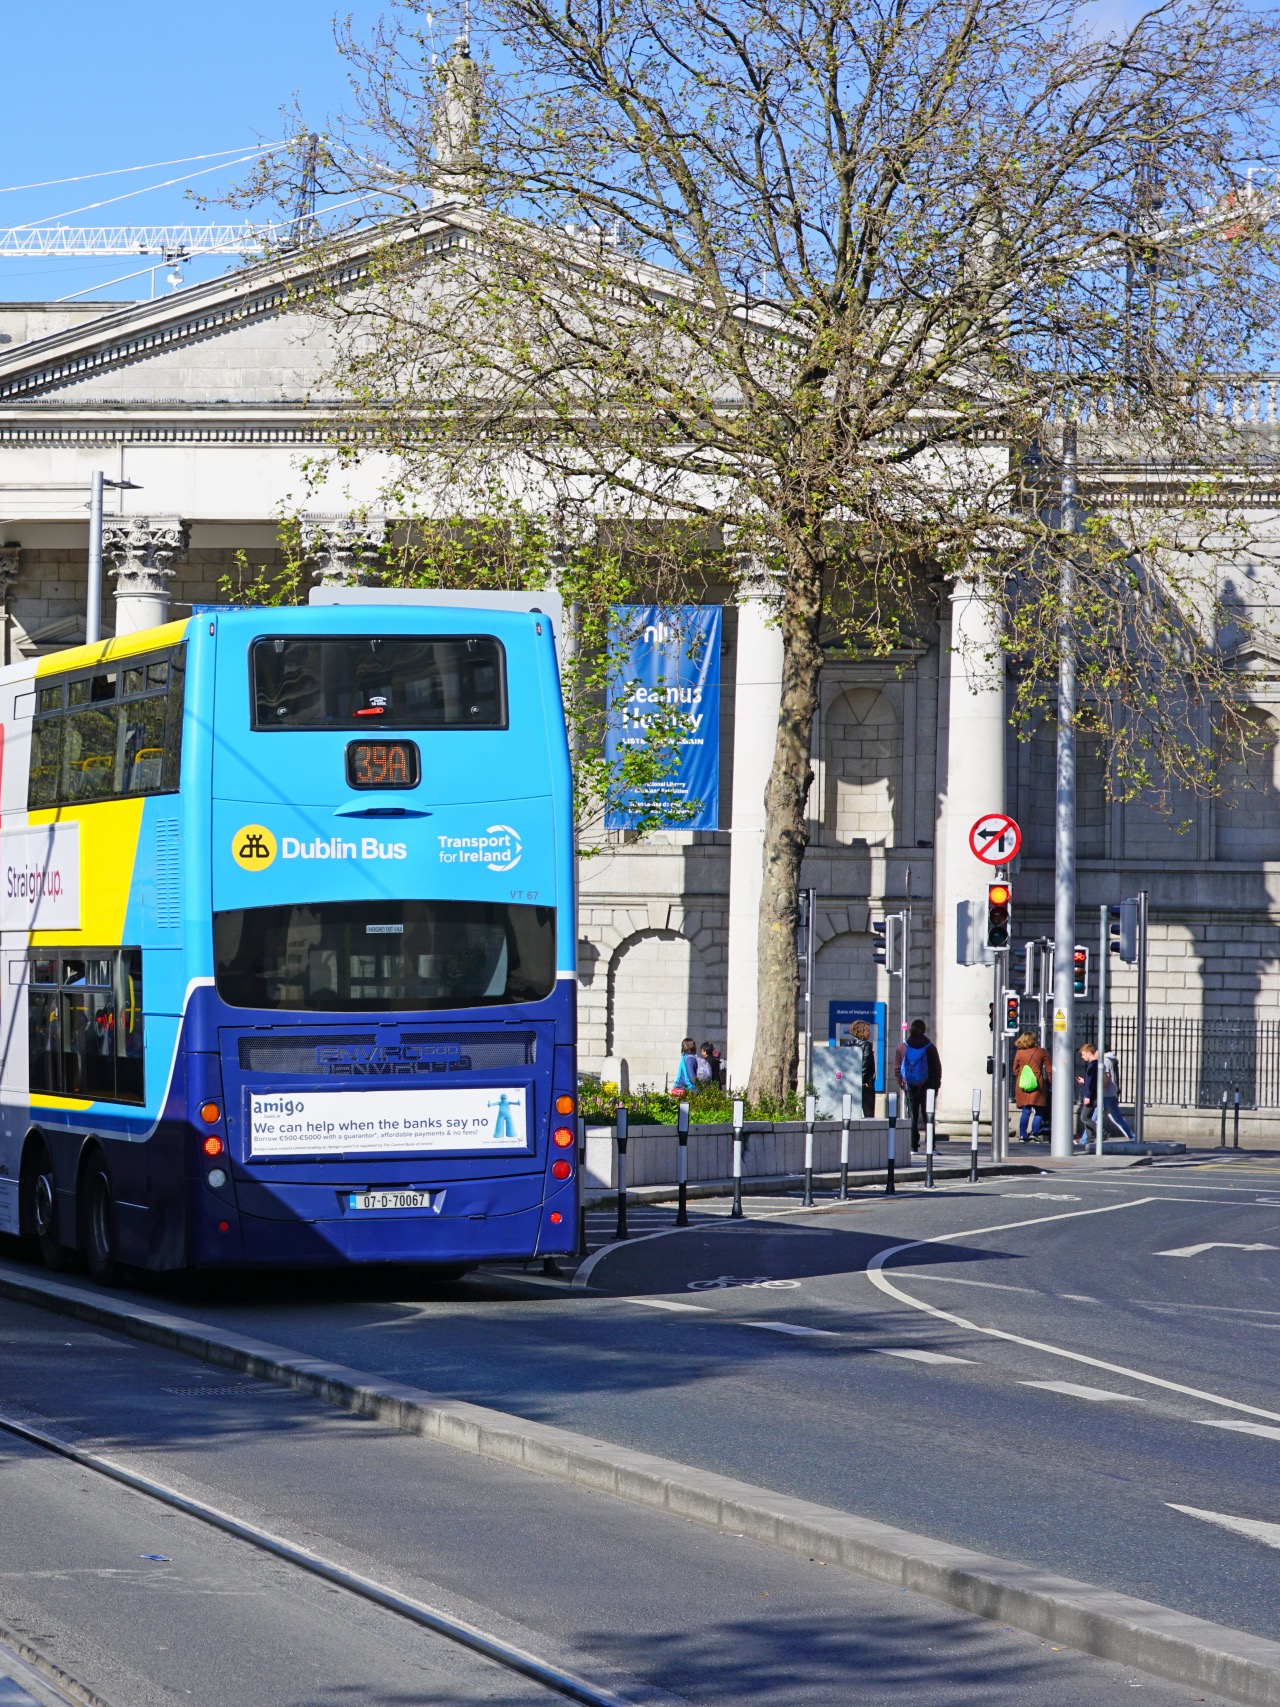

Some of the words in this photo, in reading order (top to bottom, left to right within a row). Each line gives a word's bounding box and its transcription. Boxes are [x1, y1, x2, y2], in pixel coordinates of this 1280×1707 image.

[356, 746, 406, 782] 39A
[282, 837, 357, 859] Dublin
[361, 838, 407, 860] Bus
[438, 834, 510, 849] Transport
[440, 852, 456, 862] for
[459, 850, 511, 862] Ireland
[7, 864, 46, 904] Straight
[47, 870, 63, 902] up.
[510, 890, 524, 899] VT
[527, 891, 539, 900] 67
[254, 1098, 304, 1116] amigo
[254, 1122, 274, 1133] We
[279, 1124, 302, 1132] can
[307, 1121, 334, 1134] help
[339, 1120, 374, 1130] when
[378, 1119, 399, 1130] the
[404, 1118, 442, 1129] banks
[446, 1118, 468, 1129] say
[472, 1118, 488, 1126] no
[364, 1194, 424, 1208] 07-D-70067
